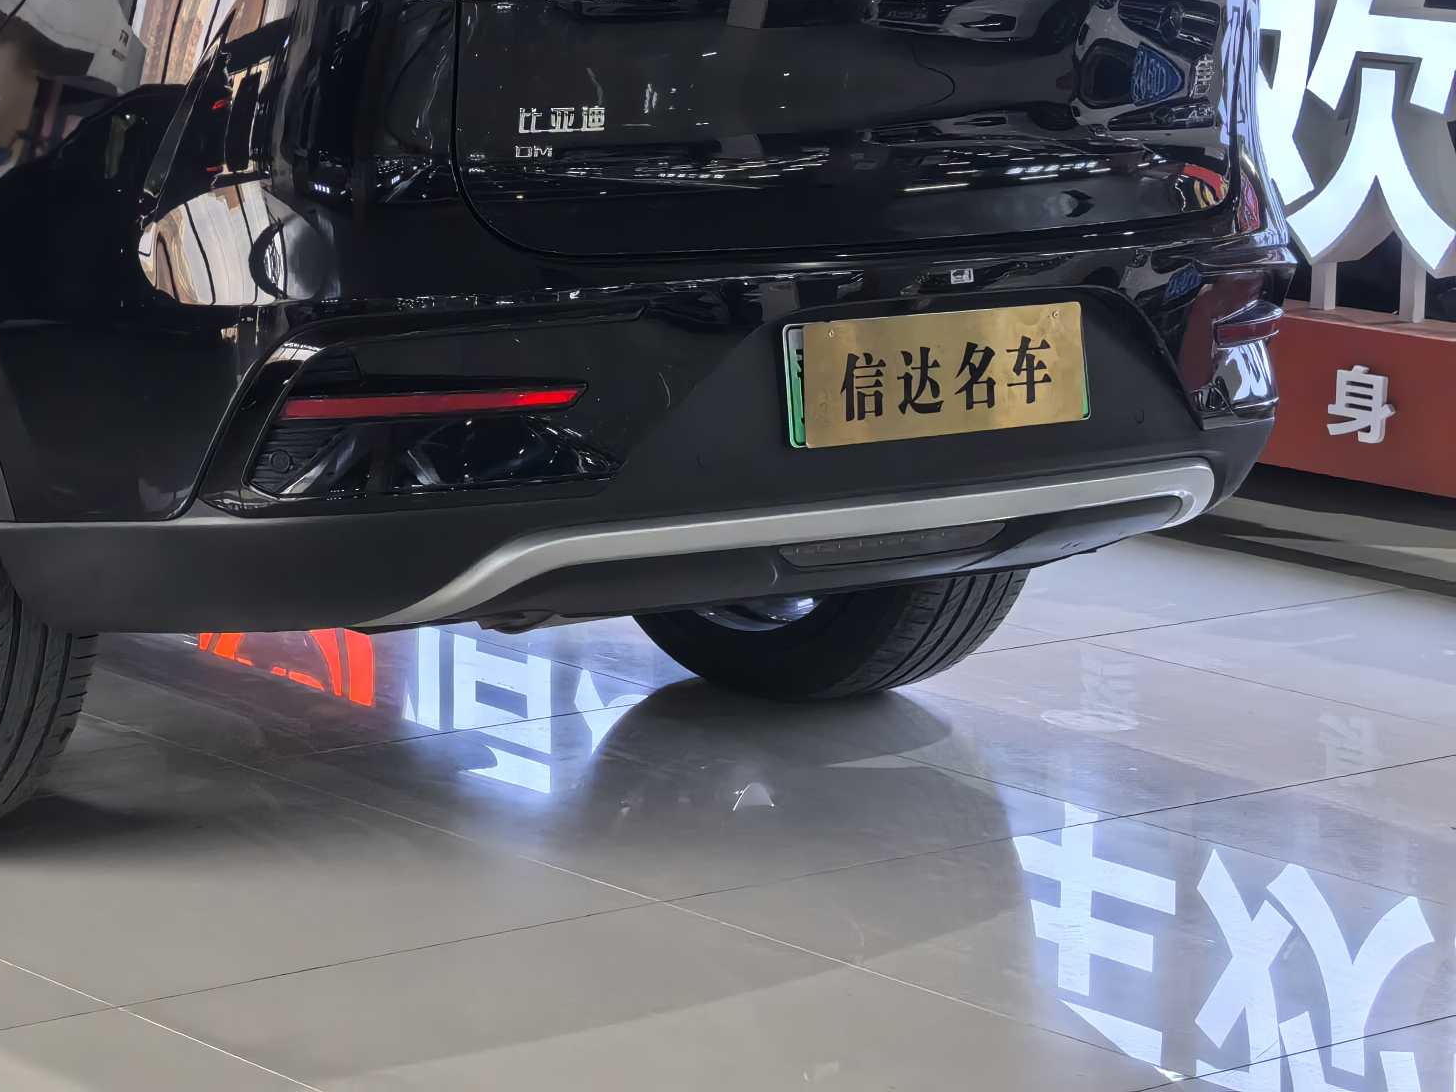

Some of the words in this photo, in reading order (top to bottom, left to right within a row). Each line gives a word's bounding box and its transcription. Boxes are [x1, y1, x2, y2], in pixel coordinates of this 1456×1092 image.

[518, 106, 605, 133] 比亚迪
[515, 146, 552, 158] DM
[841, 335, 1051, 421] 信达名车
[1327, 364, 1394, 444] 身
